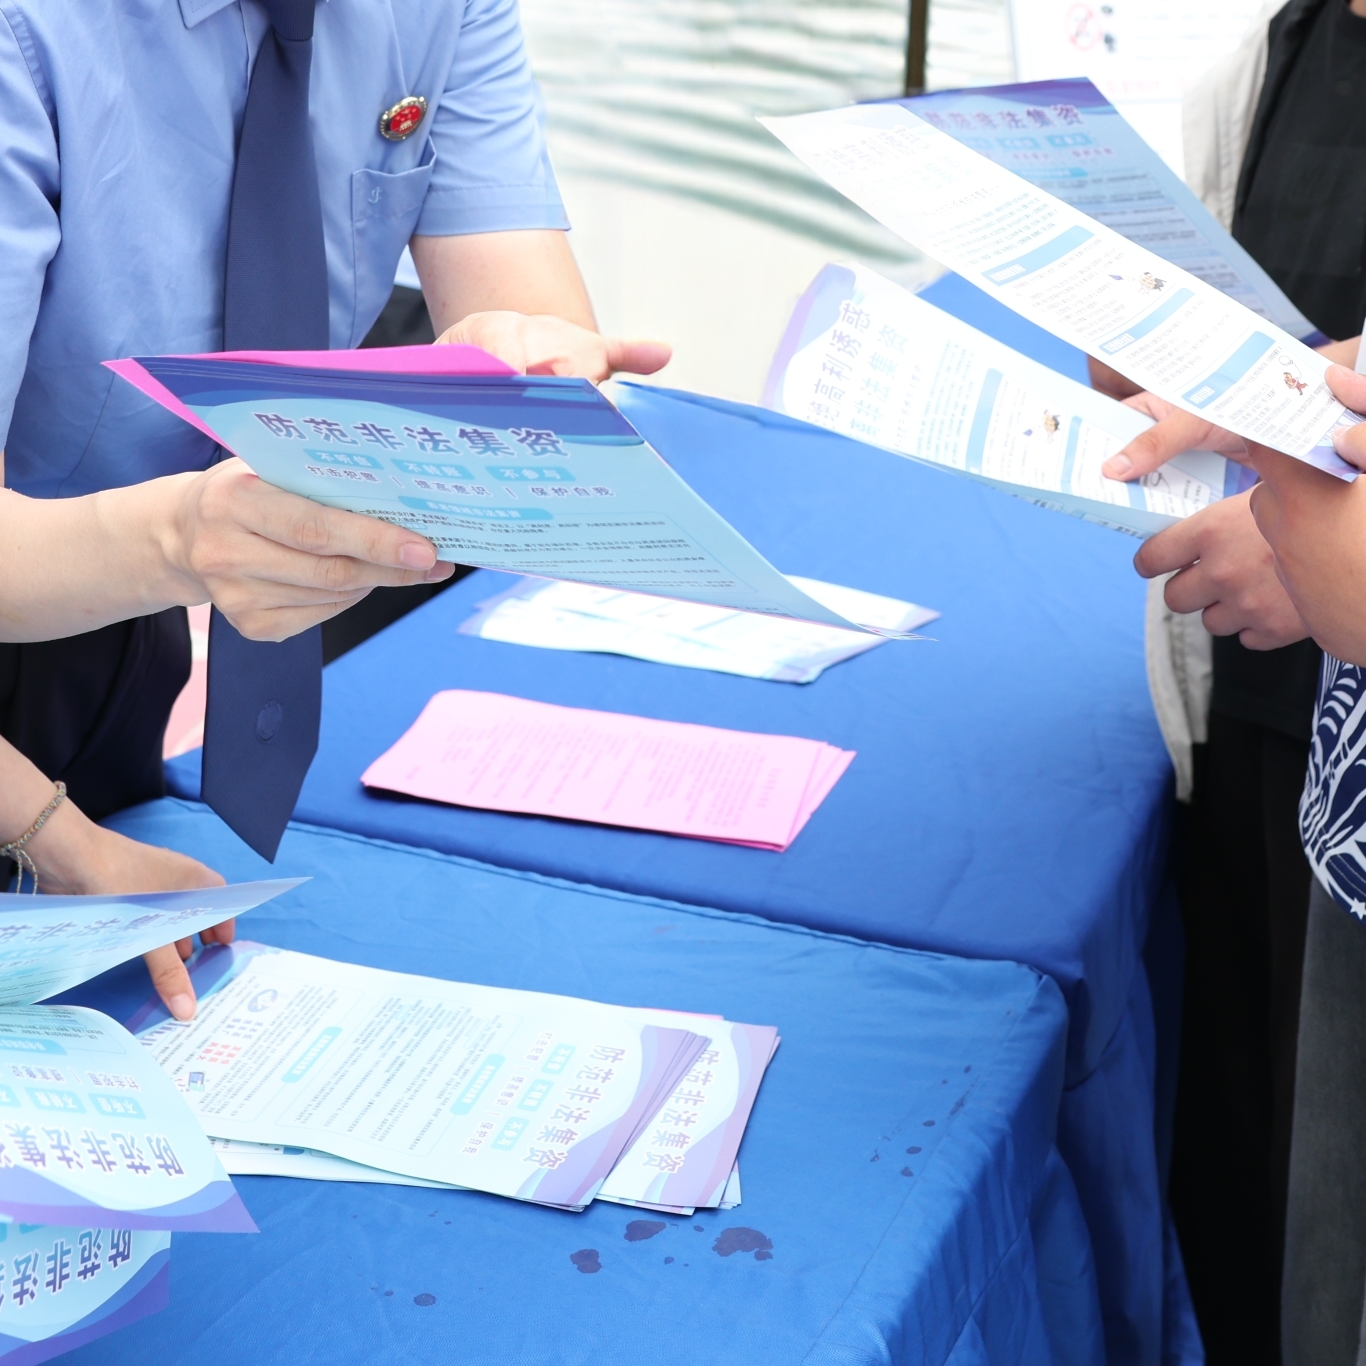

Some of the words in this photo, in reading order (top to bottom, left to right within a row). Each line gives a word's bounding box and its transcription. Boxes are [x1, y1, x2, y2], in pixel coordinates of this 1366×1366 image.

[848, 324, 910, 438] 离非法集资
[254, 411, 570, 459] 防范非法集资
[306, 464, 380, 483] 打击犯罪
[415, 478, 492, 497] 提高意识
[531, 485, 615, 497] 保护自我
[316, 450, 372, 468] 不听信
[500, 467, 563, 481] 不参与
[98, 1097, 137, 1114] 不听信
[523, 1043, 627, 1171] 防范非法集资
[641, 1048, 721, 1173] 防范非法集资
[462, 1120, 494, 1156] 保护自我
[497, 1120, 524, 1148] 不参与
